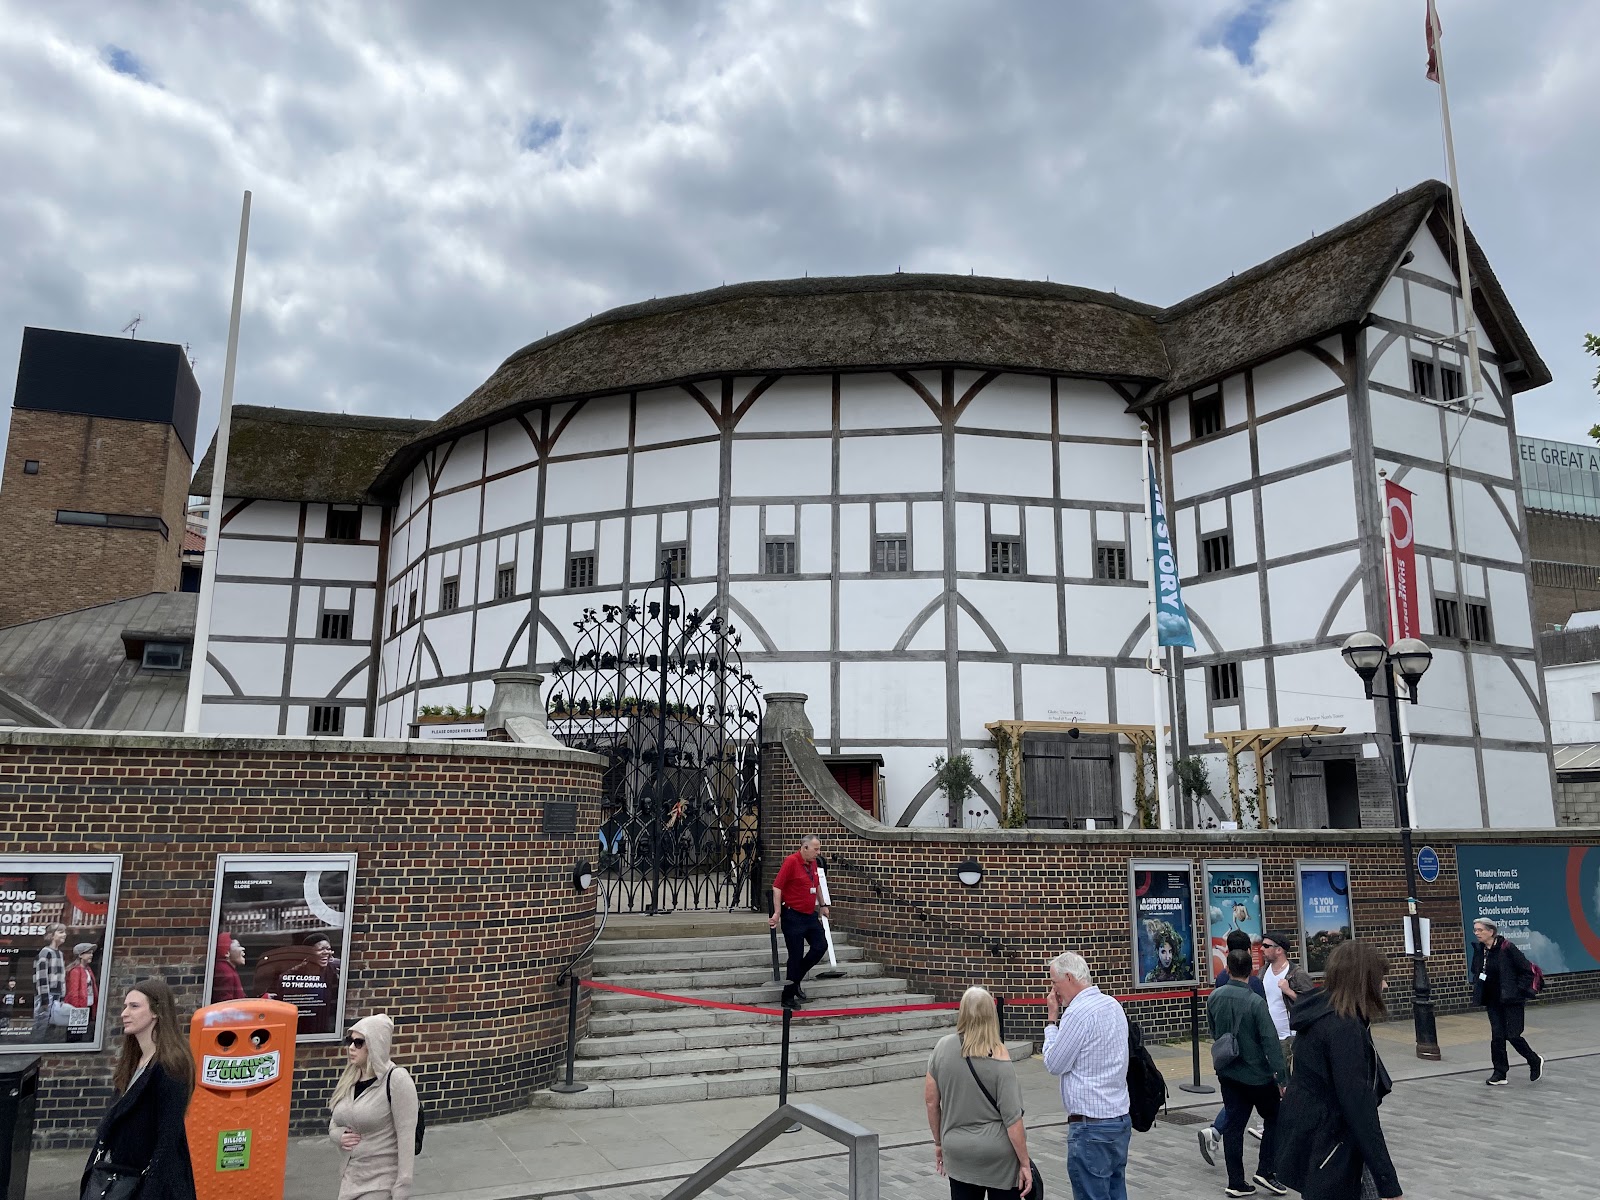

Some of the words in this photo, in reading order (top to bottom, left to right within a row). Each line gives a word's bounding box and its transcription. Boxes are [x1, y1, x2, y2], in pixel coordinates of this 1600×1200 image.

[1541, 447, 1584, 469] GREAT
[1590, 454, 1600, 471] A
[1156, 521, 1180, 610] STORY
[1474, 869, 1497, 878] Theatre
[1497, 868, 1511, 877] from
[1217, 878, 1245, 887] COMEDY
[1476, 881, 1494, 892] Family
[1495, 881, 1520, 890] activities
[1212, 886, 1222, 894] OF
[1223, 886, 1251, 894] ERRORS
[1309, 897, 1319, 905] AS
[1319, 897, 1334, 906] YOU
[1477, 893, 1497, 902] Guided
[1498, 894, 1512, 902] tours
[0, 902, 42, 912] TORS
[1315, 905, 1331, 913] LIKE
[1332, 905, 1338, 913] IT
[1478, 906, 1500, 915] Schools
[1501, 905, 1530, 915] workshops
[0, 913, 31, 924] ORT
[1495, 918, 1508, 929] rsity
[1503, 930, 1529, 939] bookshop
[207, 1054, 276, 1070] VILLAINS
[218, 1066, 258, 1080] ONLY
[223, 1136, 247, 1144] BILLION
